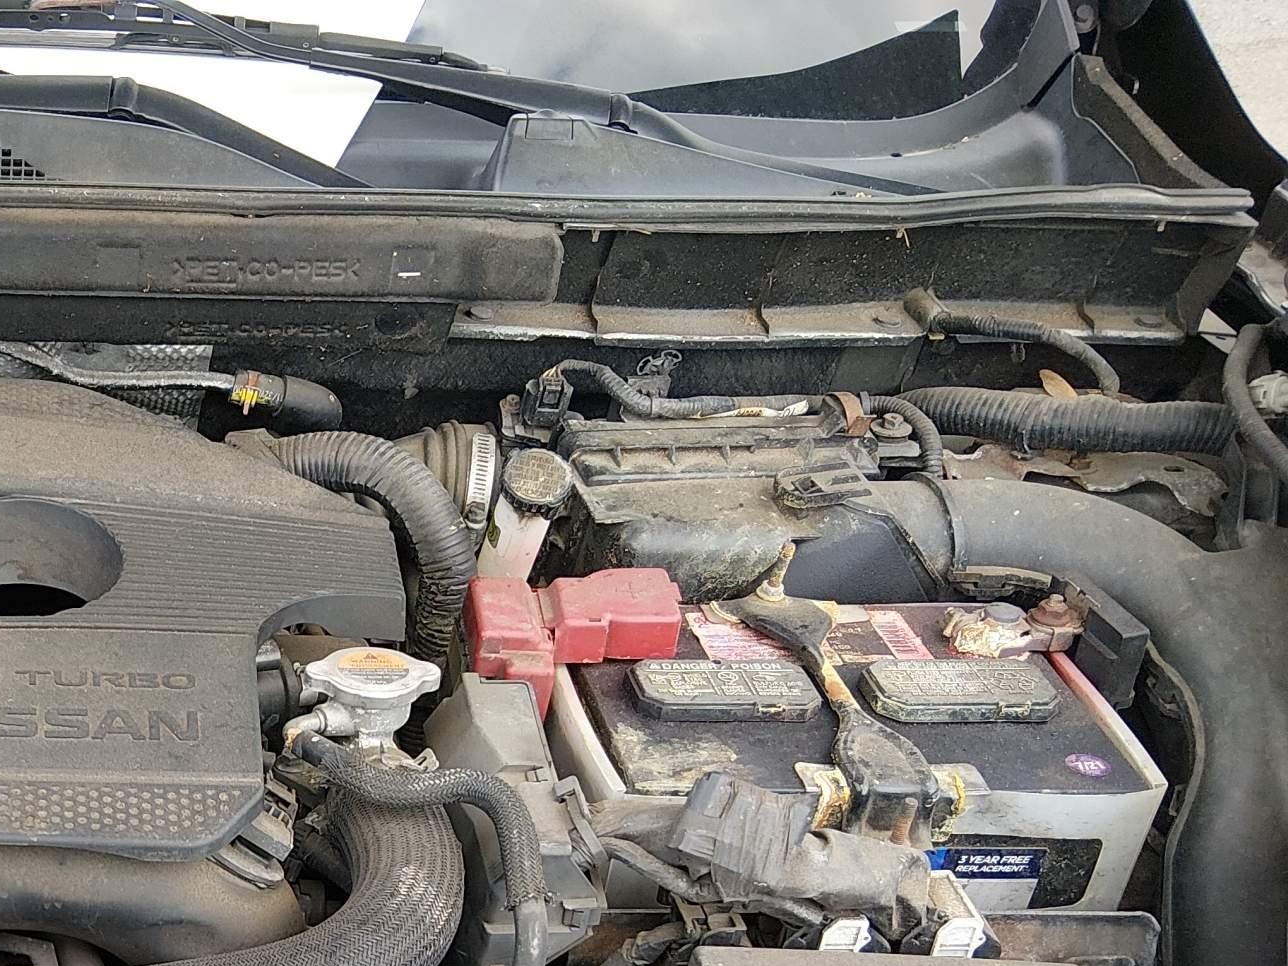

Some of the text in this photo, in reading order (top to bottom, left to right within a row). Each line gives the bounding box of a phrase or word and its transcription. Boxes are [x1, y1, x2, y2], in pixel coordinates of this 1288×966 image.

[15, 670, 196, 689] TURBO
[958, 855, 1031, 865] 3 YEAR FREE
